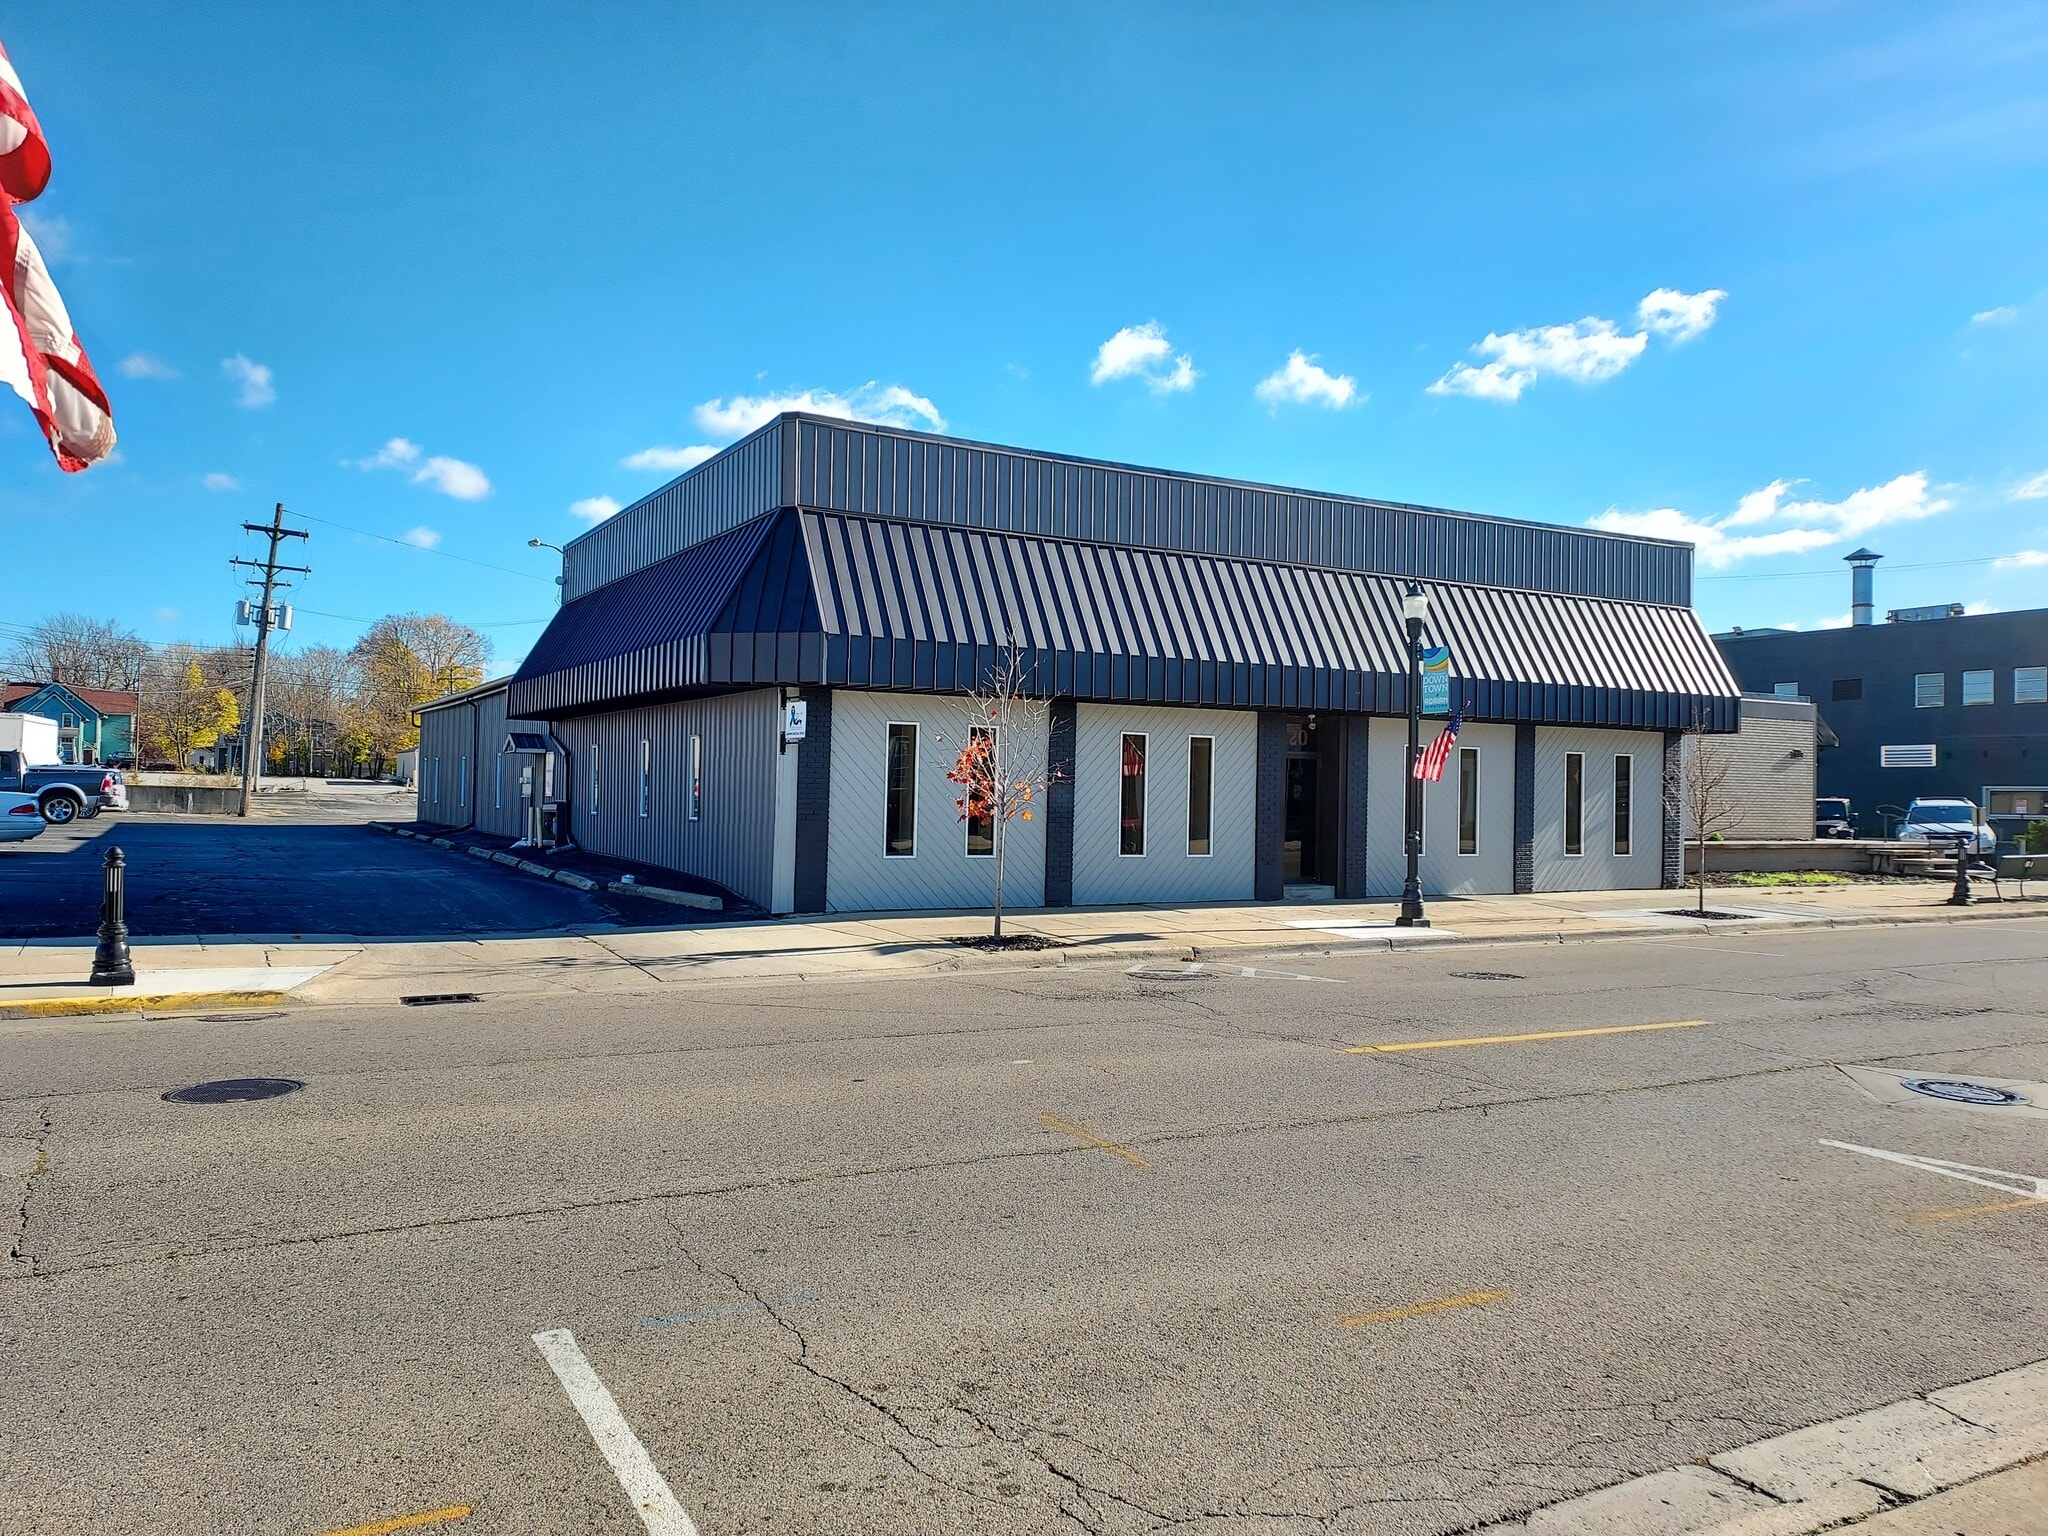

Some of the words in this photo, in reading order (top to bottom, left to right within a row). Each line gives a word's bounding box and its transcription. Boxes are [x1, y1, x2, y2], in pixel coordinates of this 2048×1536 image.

[1423, 675, 1448, 684] DOWN
[1423, 684, 1448, 693] TOWN
[1289, 729, 1308, 746] 20
